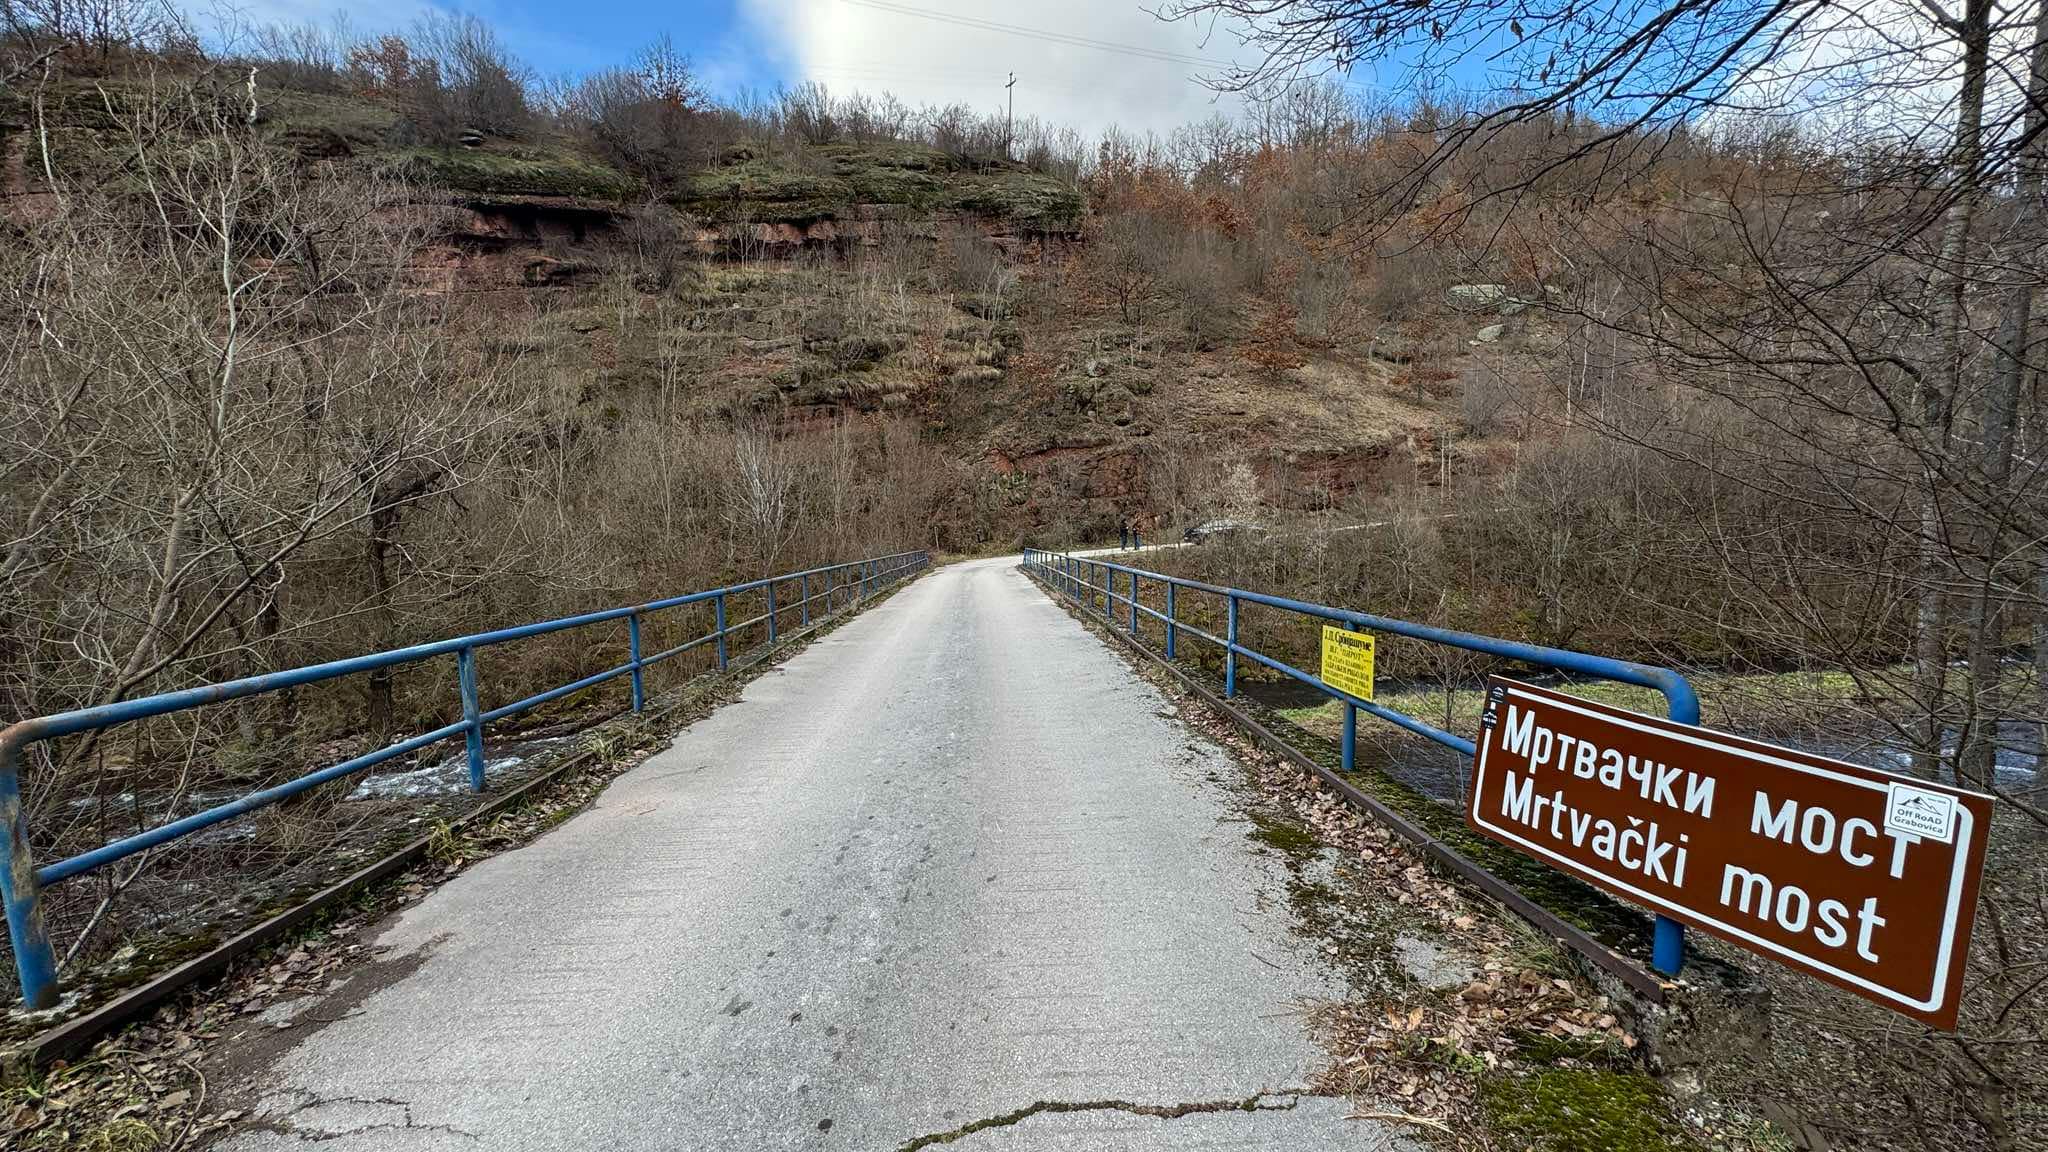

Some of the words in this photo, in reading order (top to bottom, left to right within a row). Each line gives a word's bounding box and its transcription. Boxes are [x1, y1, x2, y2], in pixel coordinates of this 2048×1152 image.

[1503, 704, 1716, 819] Мртвачки
[1751, 790, 1921, 879] мост
[1894, 816, 1943, 834] Grabovica
[1897, 808, 1913, 818] Off
[1914, 814, 1942, 825] RoAD
[1502, 770, 1688, 889] Mrtvački
[1720, 863, 1886, 964] most
